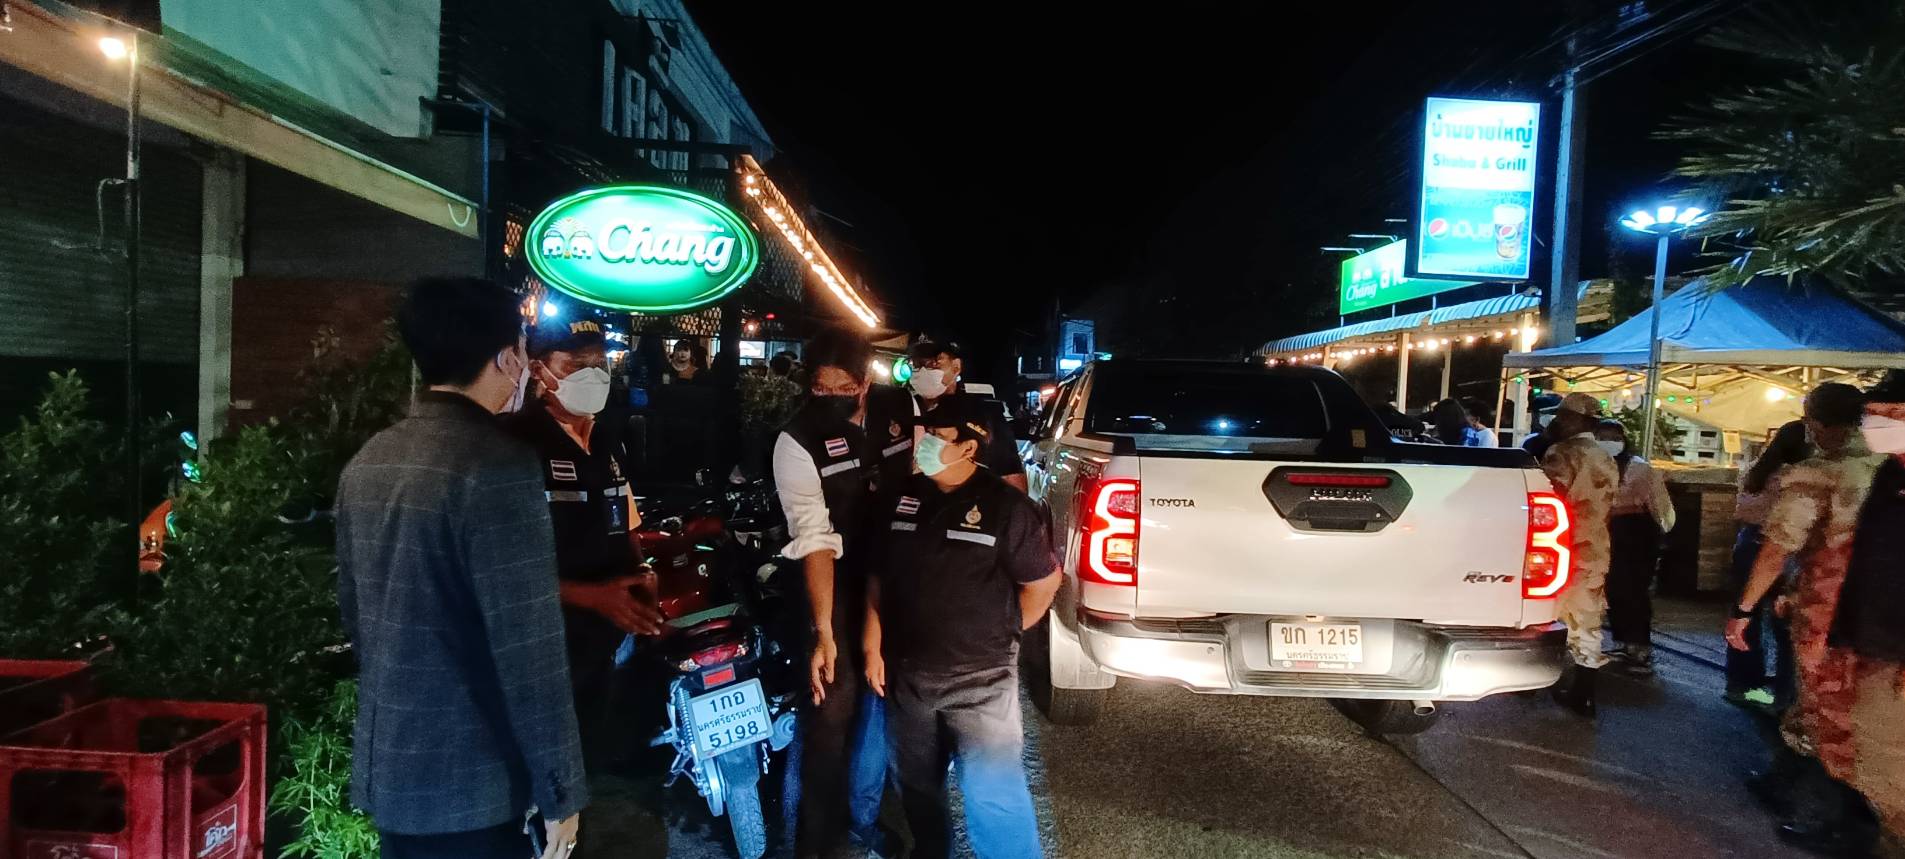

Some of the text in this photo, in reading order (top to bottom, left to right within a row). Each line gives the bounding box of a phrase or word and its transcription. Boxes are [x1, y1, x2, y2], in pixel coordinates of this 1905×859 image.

[1496, 156, 1527, 171] Grill
[598, 218, 736, 275] Chang
[1149, 498, 1196, 508] TOYOTA
[1281, 626, 1358, 646] ขก 1215
[710, 691, 745, 713] 1กอ
[697, 703, 762, 732] นครศรีธรรมราช
[709, 720, 759, 748] 5198
